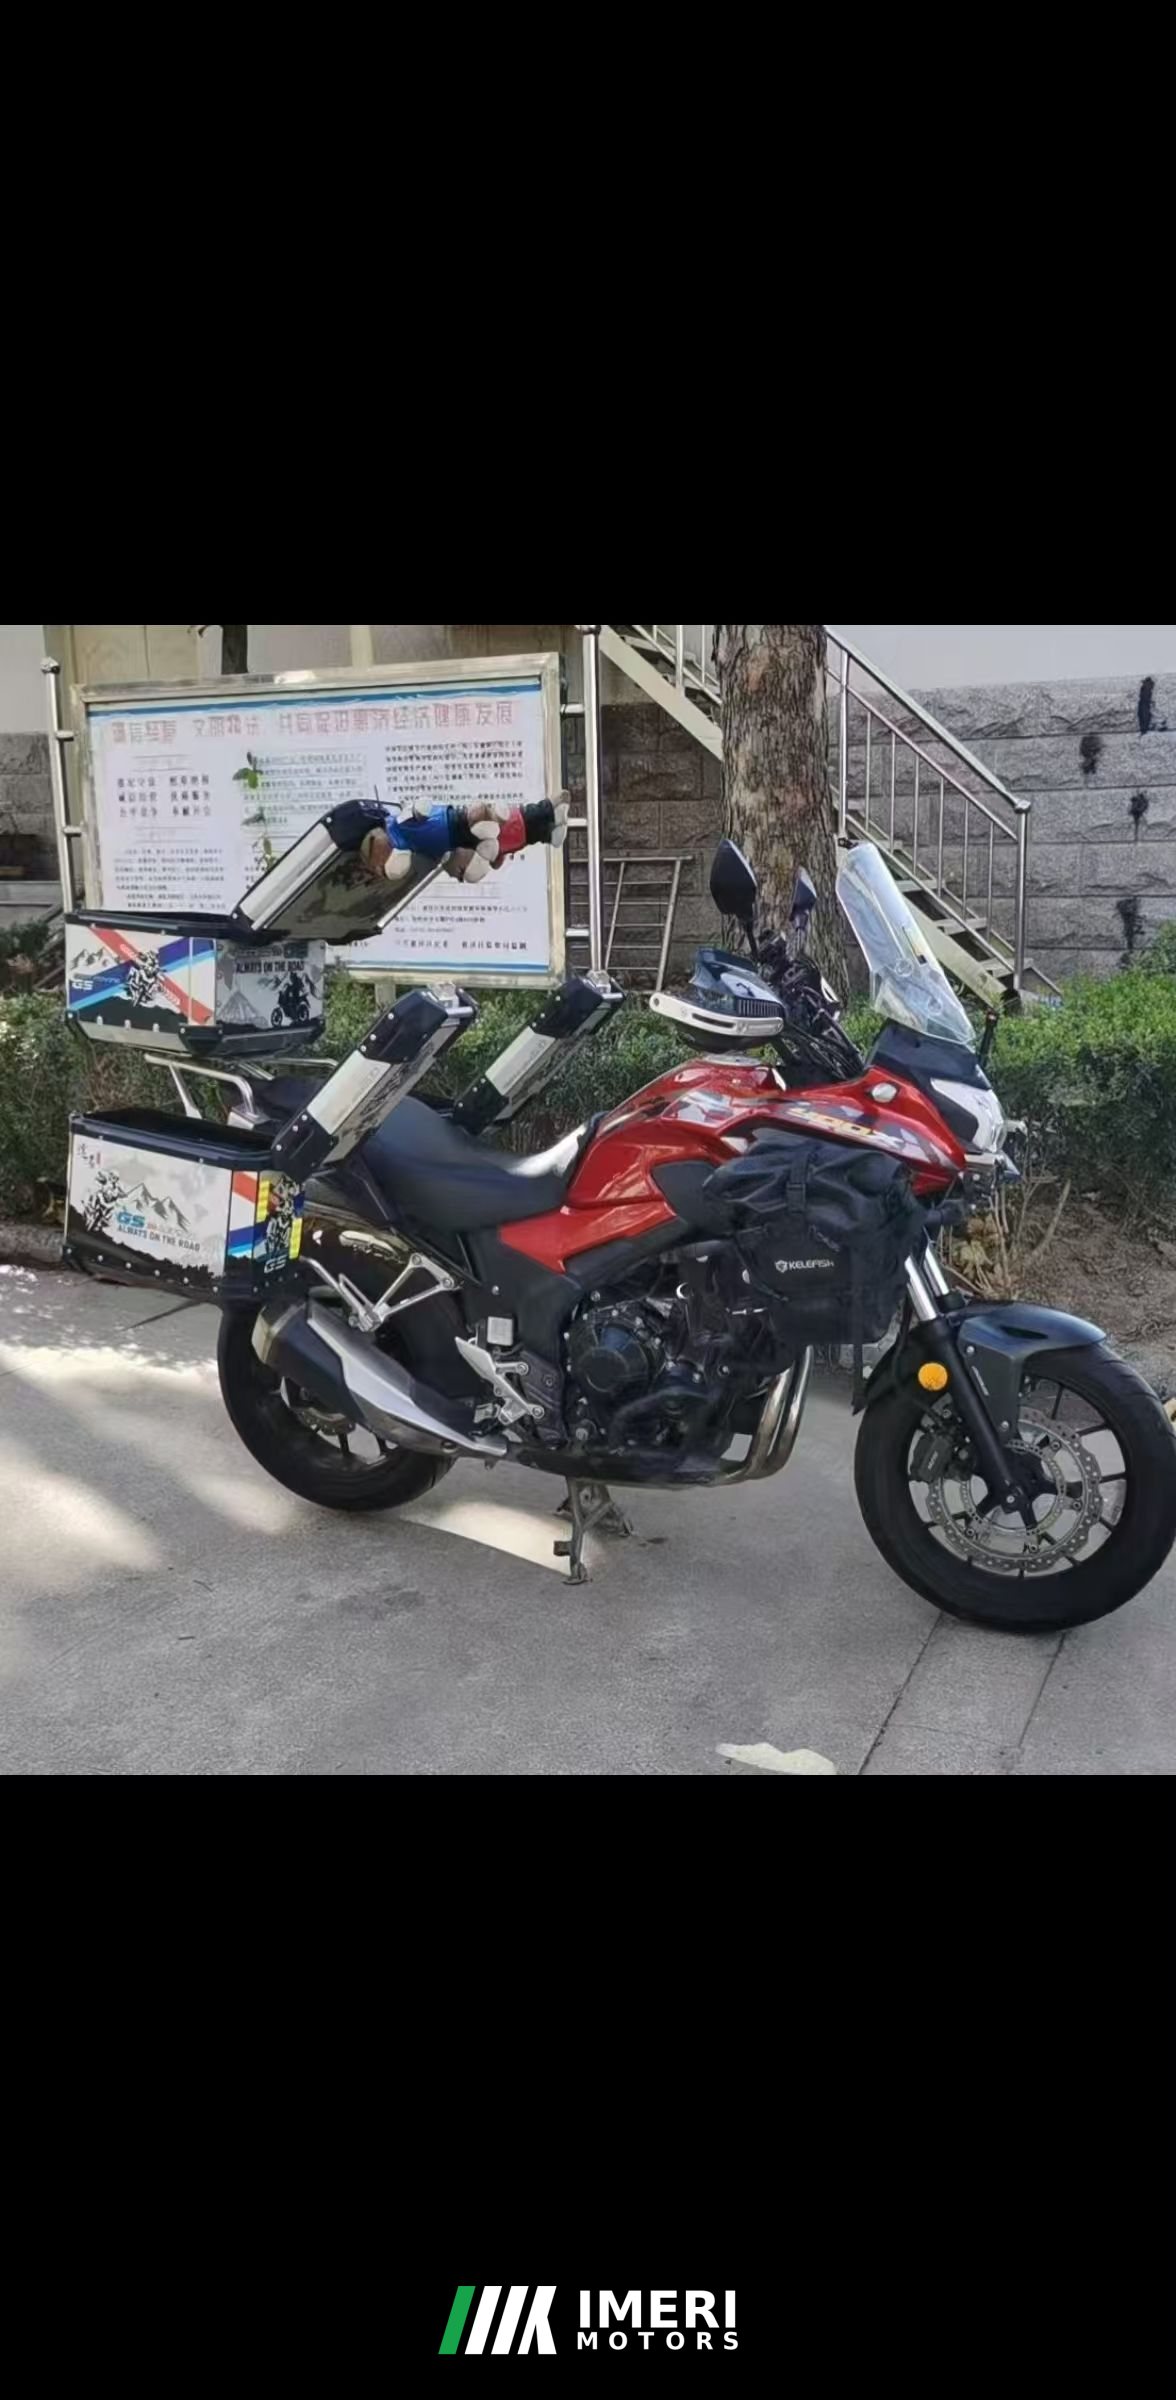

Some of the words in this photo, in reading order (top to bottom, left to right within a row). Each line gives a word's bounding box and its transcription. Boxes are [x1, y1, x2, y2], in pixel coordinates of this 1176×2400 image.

[115, 1211, 146, 1228] GS
[118, 1225, 148, 1240] ALWAYS
[149, 1233, 161, 1243] ON
[162, 1235, 176, 1247] THE
[178, 1239, 200, 1251] ROAD
[263, 1255, 288, 1274] GS
[789, 1258, 835, 1270] KELEFISH
